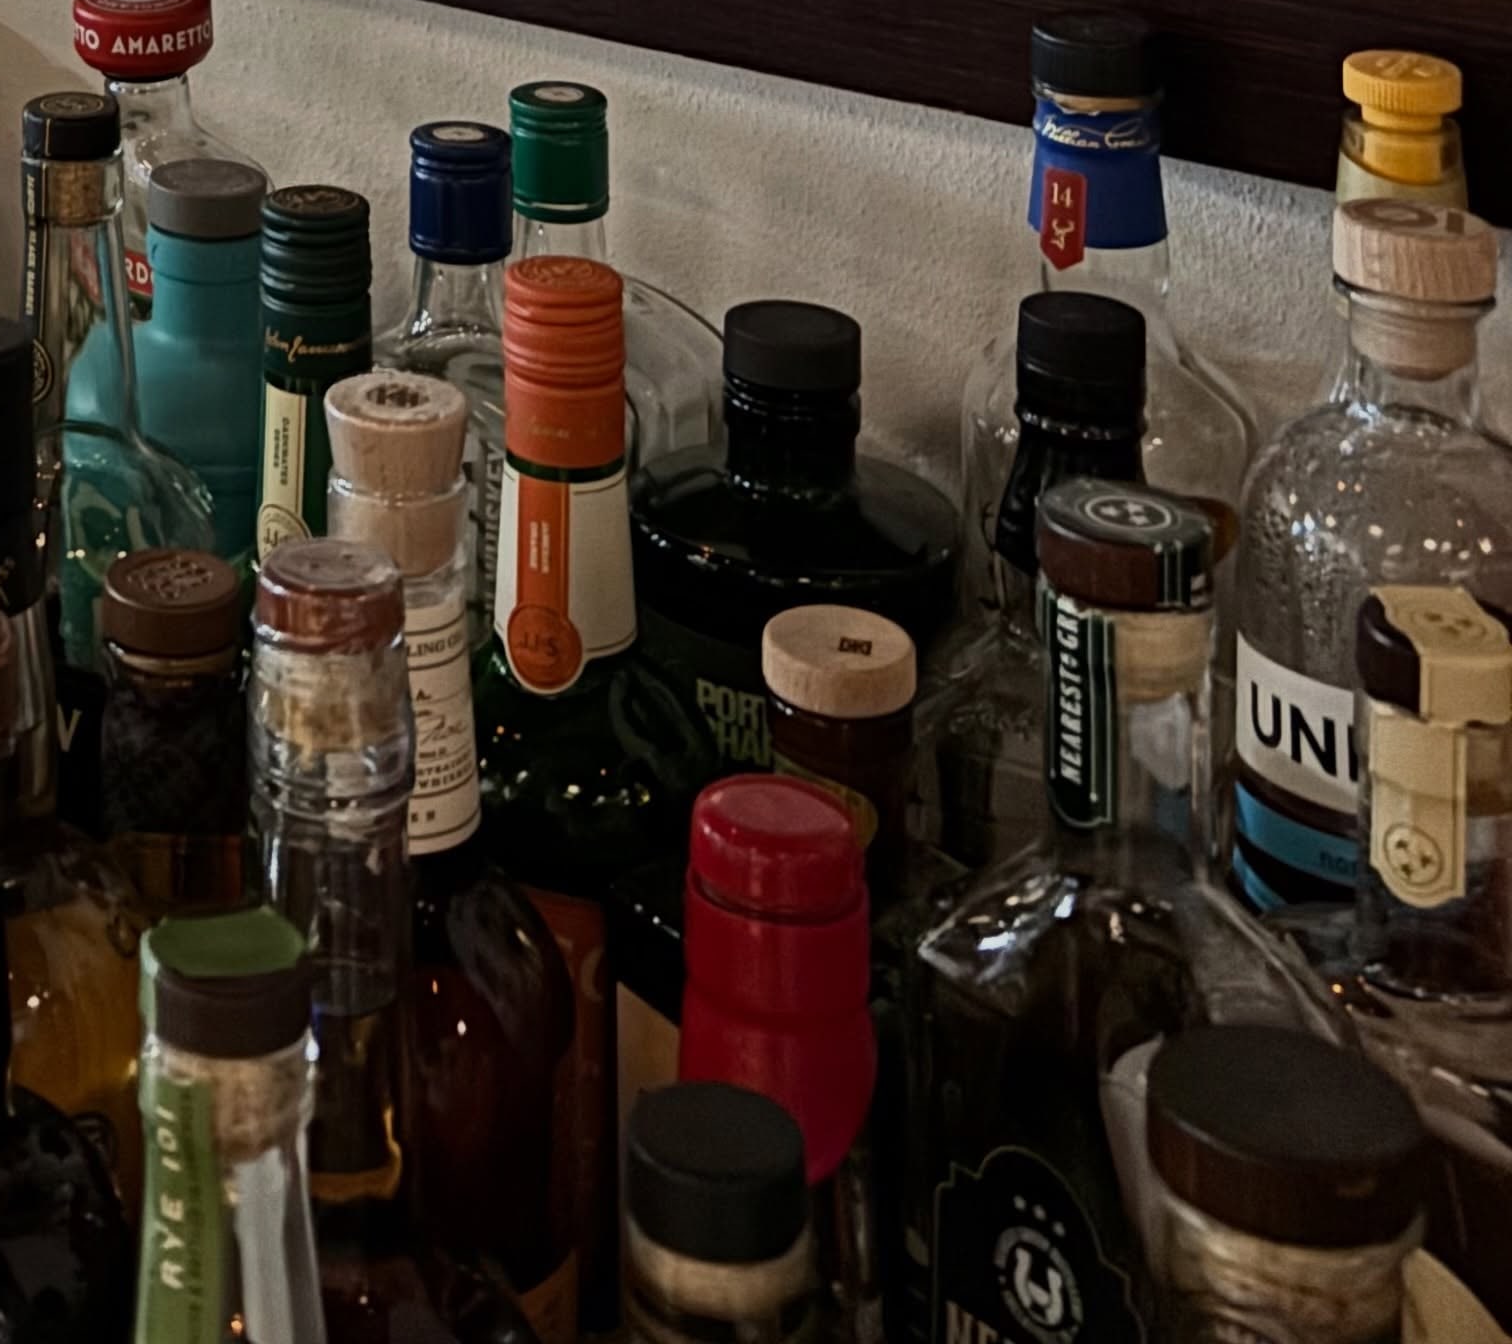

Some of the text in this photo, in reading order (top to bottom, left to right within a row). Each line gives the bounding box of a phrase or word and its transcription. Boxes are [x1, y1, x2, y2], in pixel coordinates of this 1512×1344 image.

[111, 20, 211, 56] AMARETTO
[1052, 181, 1074, 209] 14
[407, 636, 446, 658] LING
[1058, 665, 1084, 786] NEAREST
[155, 1194, 186, 1289] RYE
